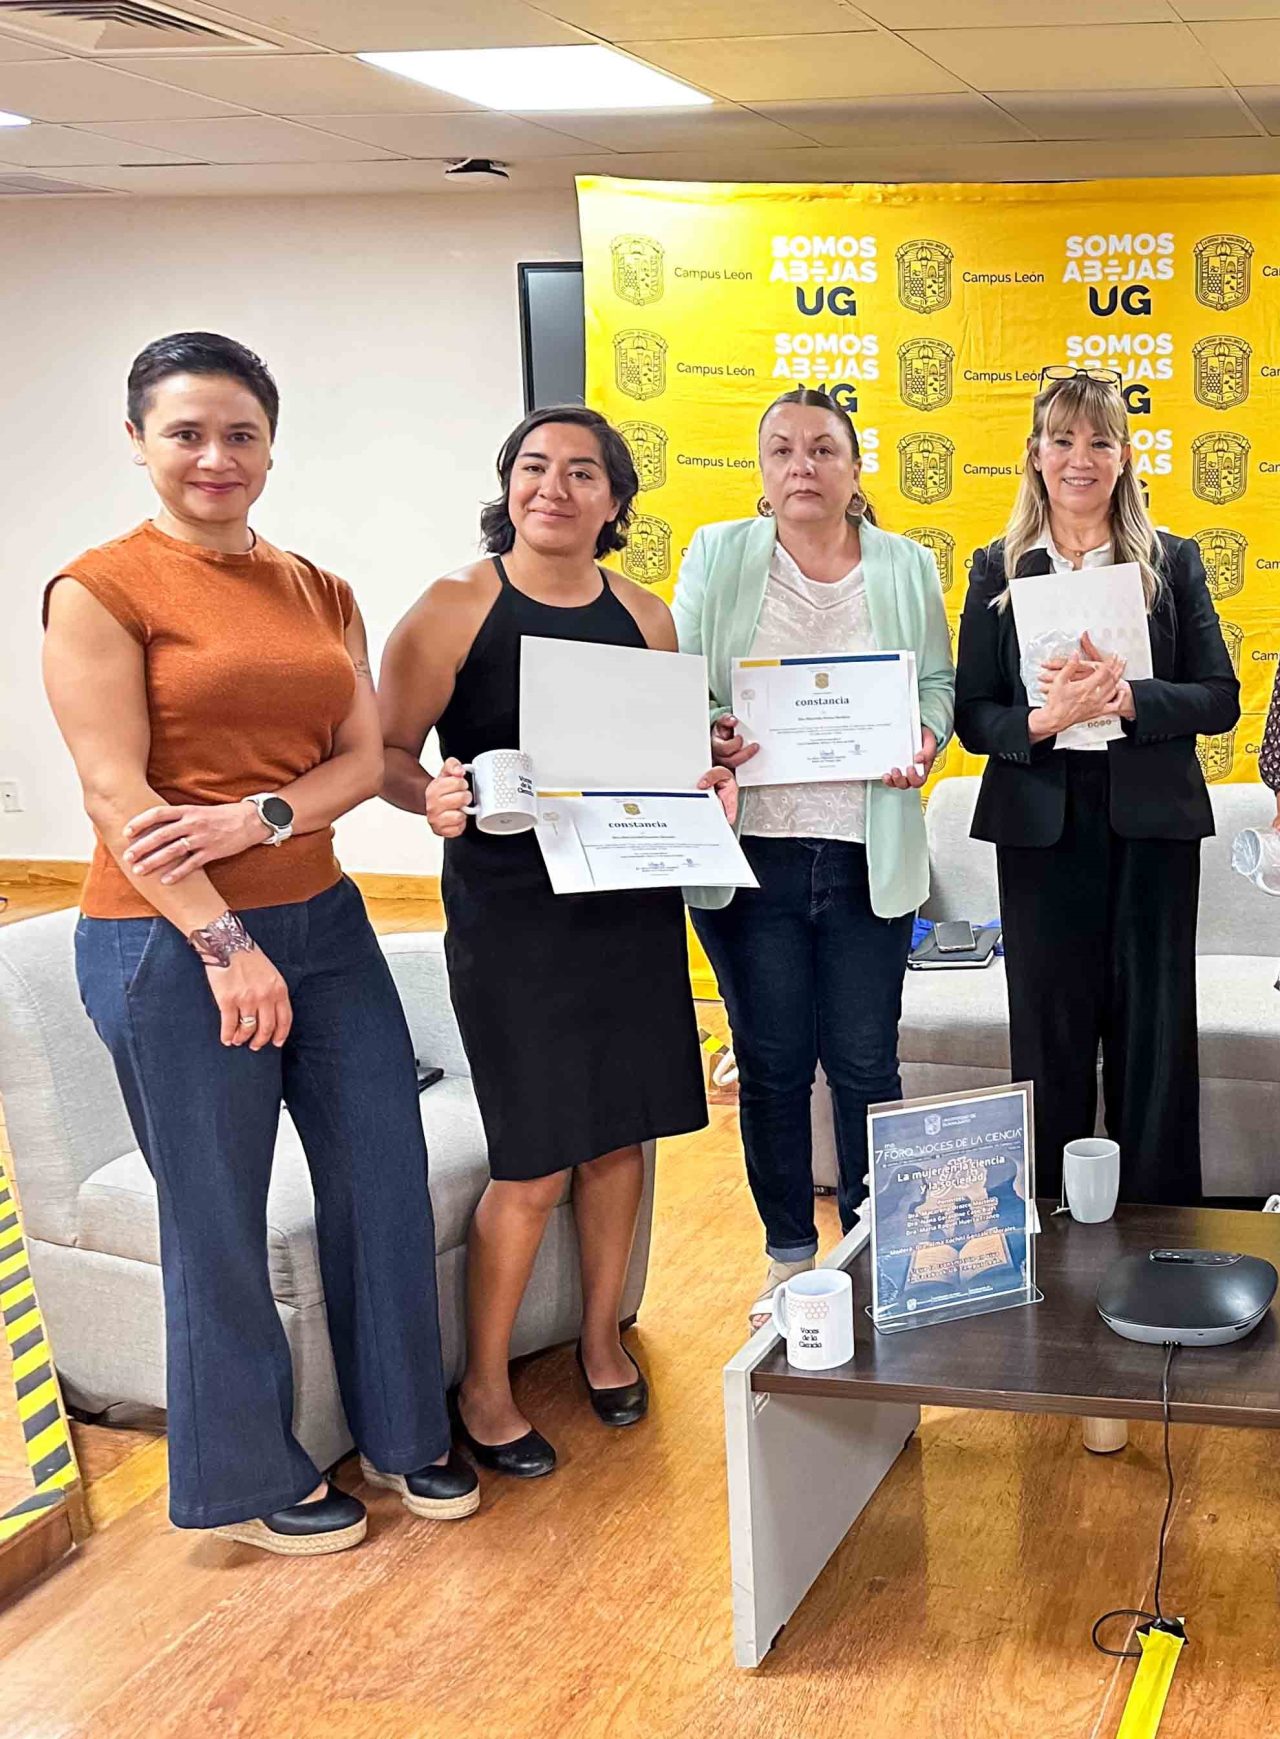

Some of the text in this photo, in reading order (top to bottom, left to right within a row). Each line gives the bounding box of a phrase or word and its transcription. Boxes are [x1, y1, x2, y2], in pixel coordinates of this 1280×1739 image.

[771, 235, 878, 259] SOMOS
[1065, 233, 1175, 258] SOMOS
[674, 267, 721, 281] Campus
[962, 271, 1044, 286] Campus León
[796, 286, 857, 316] UG
[1089, 284, 1152, 317] UG
[774, 333, 880, 356] SOMOS
[1065, 333, 1174, 357] SOMOS
[676, 362, 755, 376] Campus León
[963, 369, 1012, 383] Campus
[798, 383, 858, 413] G
[1115, 384, 1151, 414] G
[676, 454, 755, 469] Campus León
[963, 463, 1012, 477] Campus
[795, 696, 850, 707] constancia
[608, 821, 668, 829] constancia
[875, 1150, 884, 1165] 7
[884, 1148, 914, 1160] FORO
[955, 1139, 968, 1149] DE
[970, 1135, 983, 1146] LA
[897, 1156, 1006, 1182] La mujer en la ciencia
[920, 1173, 984, 1194] y la sociedad
